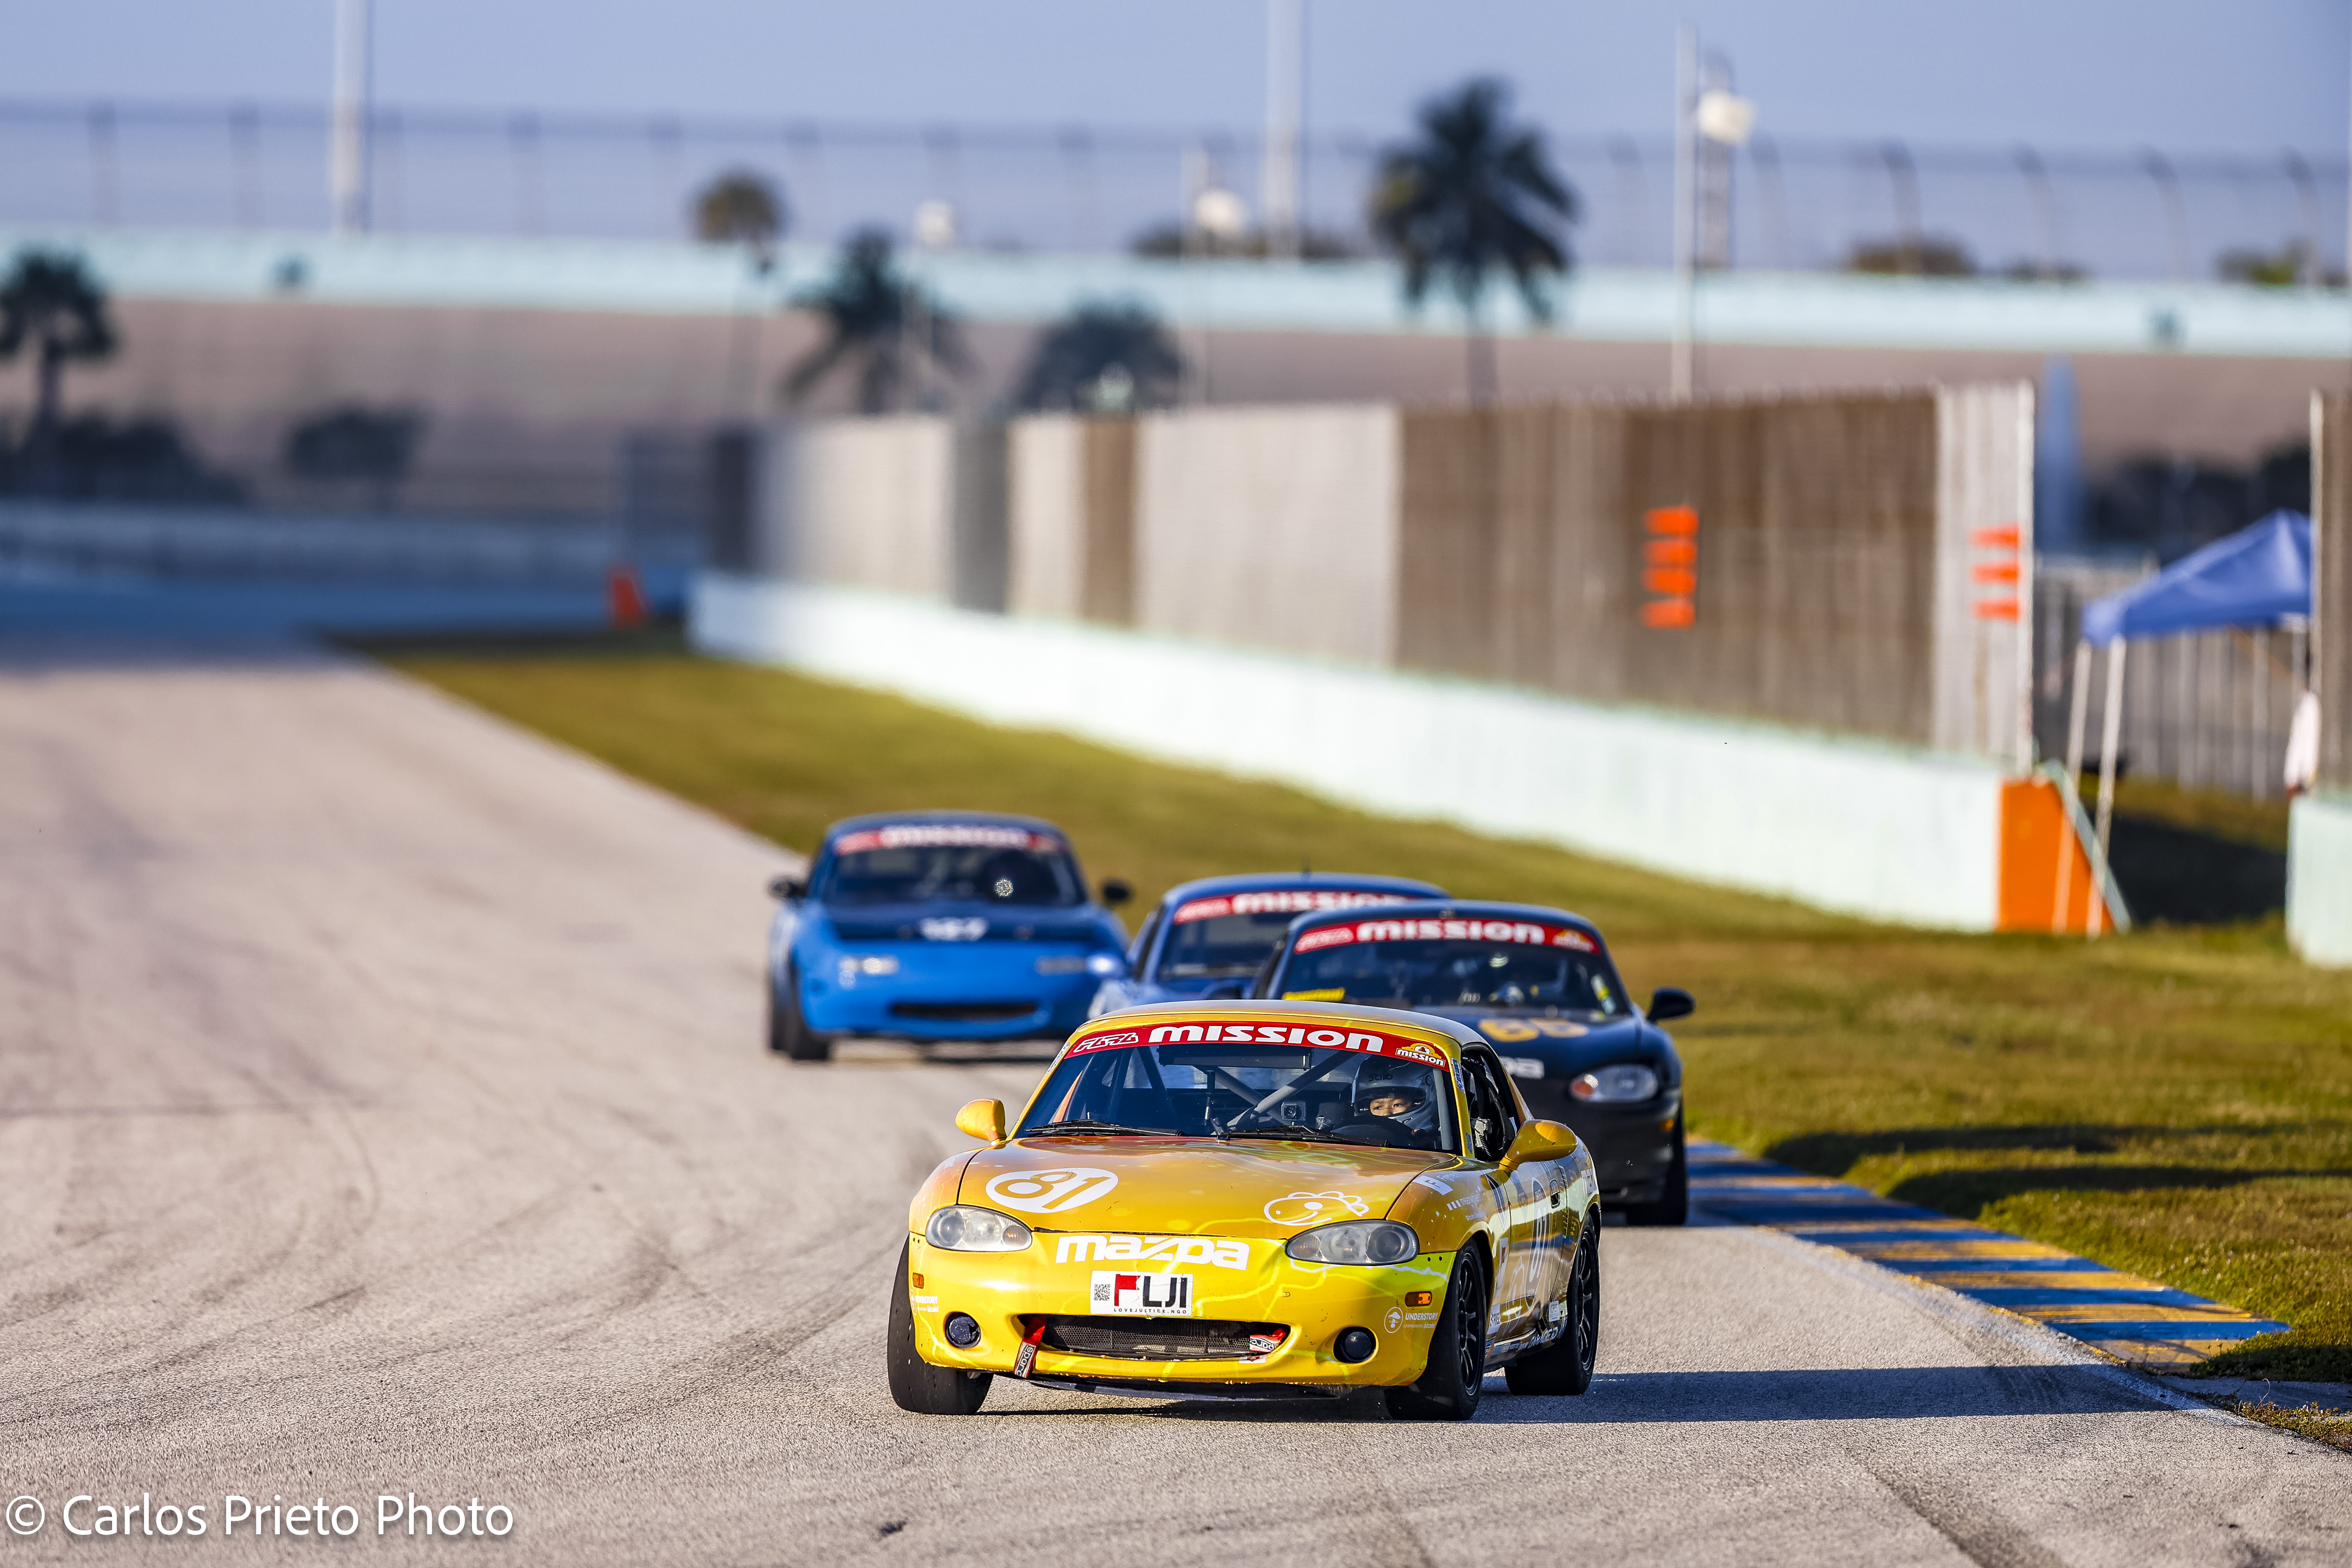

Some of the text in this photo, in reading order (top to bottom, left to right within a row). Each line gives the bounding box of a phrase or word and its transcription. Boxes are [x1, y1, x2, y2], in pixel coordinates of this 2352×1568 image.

[1357, 920, 1545, 944] mission
[1149, 1025, 1383, 1053] mission
[1397, 1049, 1444, 1066] mission
[995, 1171, 1111, 1210] 81
[1056, 1235, 1250, 1270] mazda
